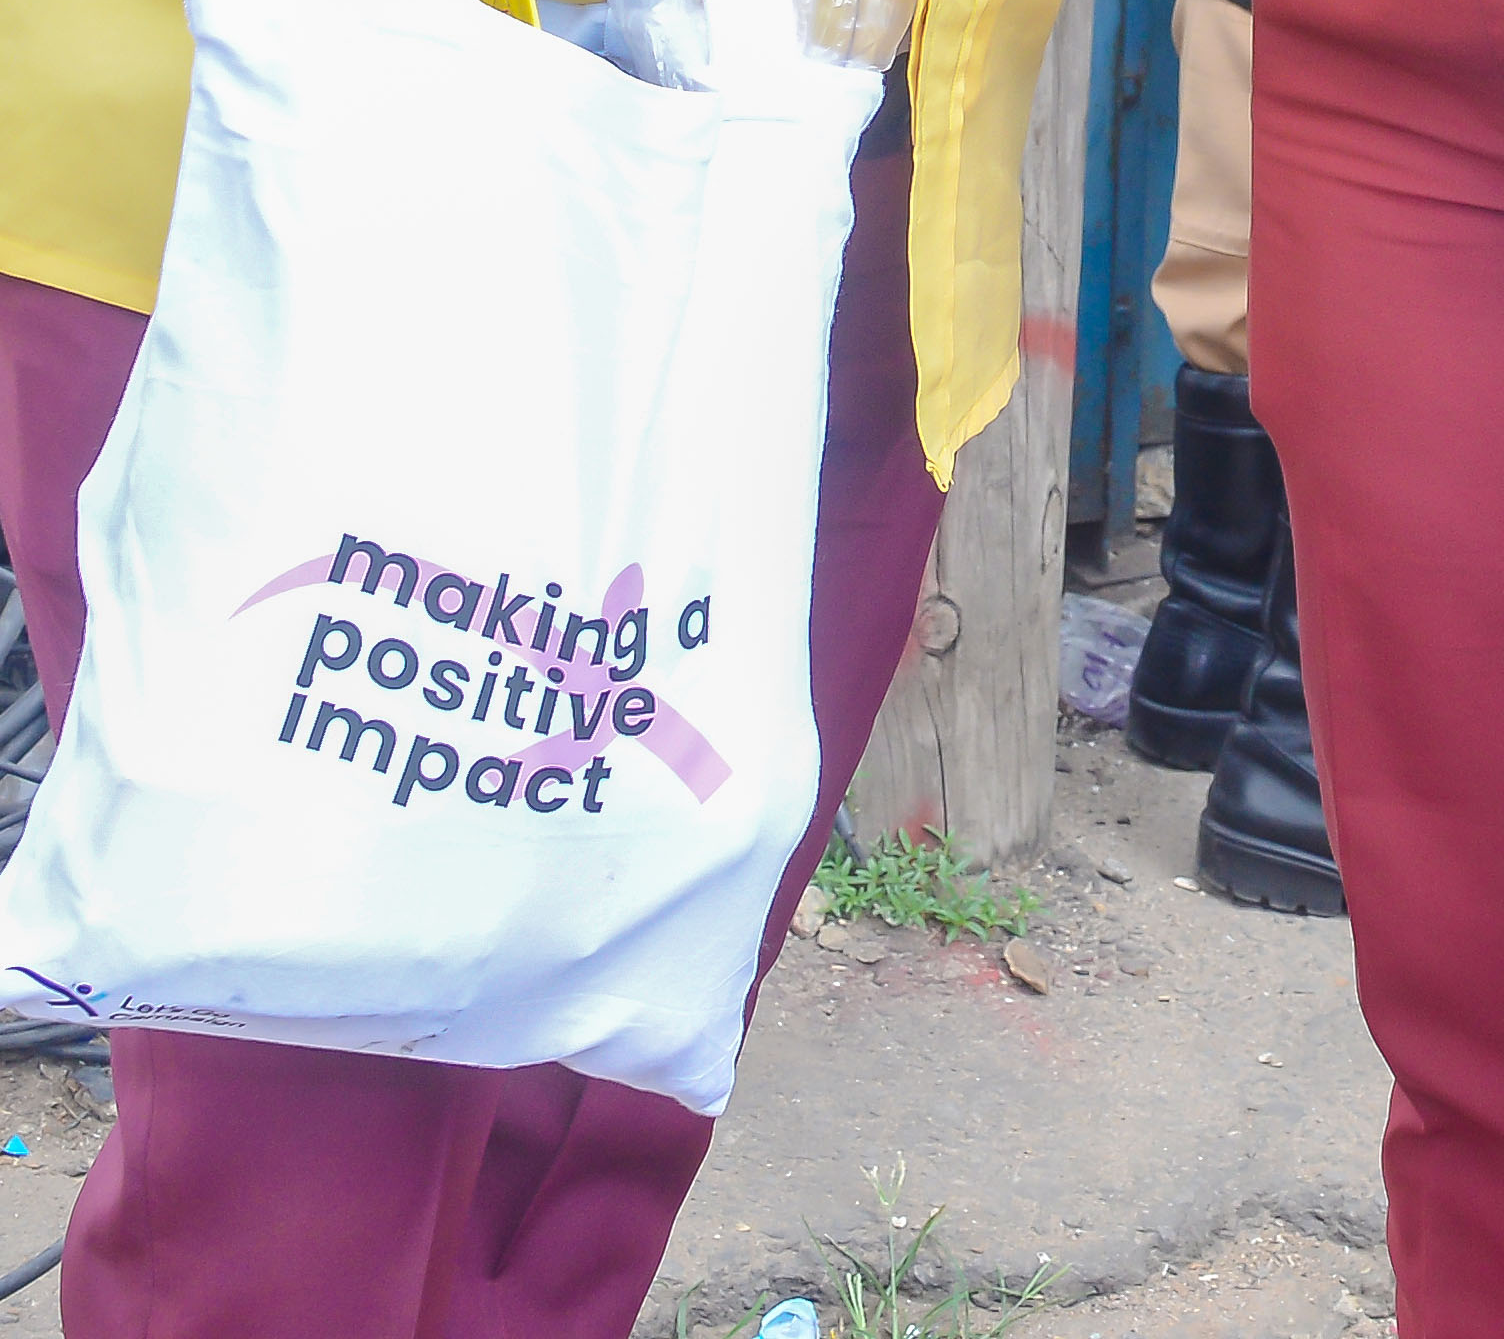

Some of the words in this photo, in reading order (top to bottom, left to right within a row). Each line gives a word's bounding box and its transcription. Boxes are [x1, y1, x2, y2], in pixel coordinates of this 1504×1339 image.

[328, 533, 648, 682] making
[678, 595, 711, 650] a
[296, 613, 656, 741] positive
[279, 689, 612, 813] impact
